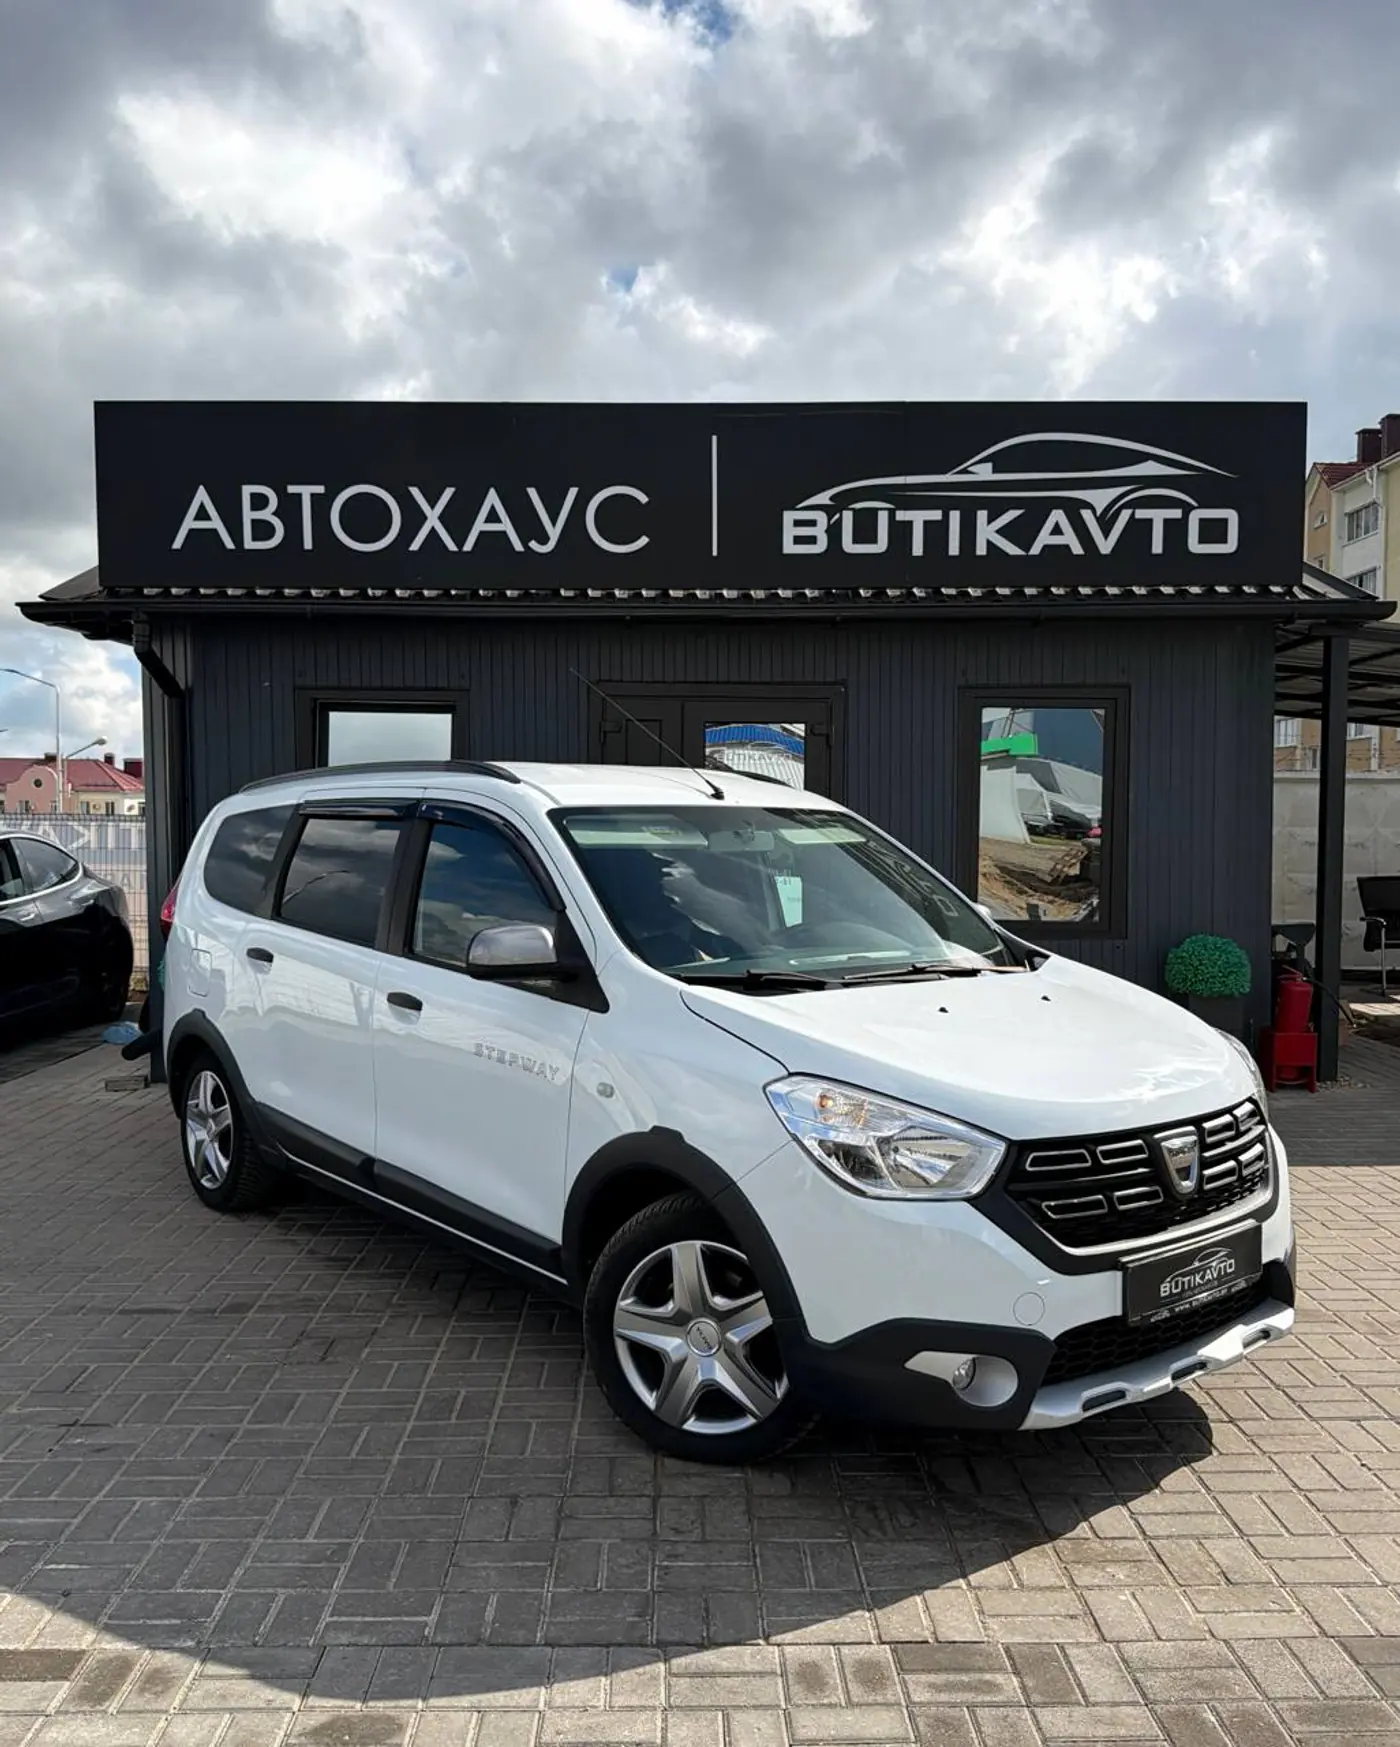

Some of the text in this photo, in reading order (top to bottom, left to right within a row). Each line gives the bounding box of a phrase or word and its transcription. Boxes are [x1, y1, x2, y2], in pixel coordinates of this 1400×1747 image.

[171, 484, 650, 554] АВТОХАУС
[782, 508, 1239, 556] BUTIKAVTO
[1160, 1259, 1235, 1297] BUTIKAVTO
